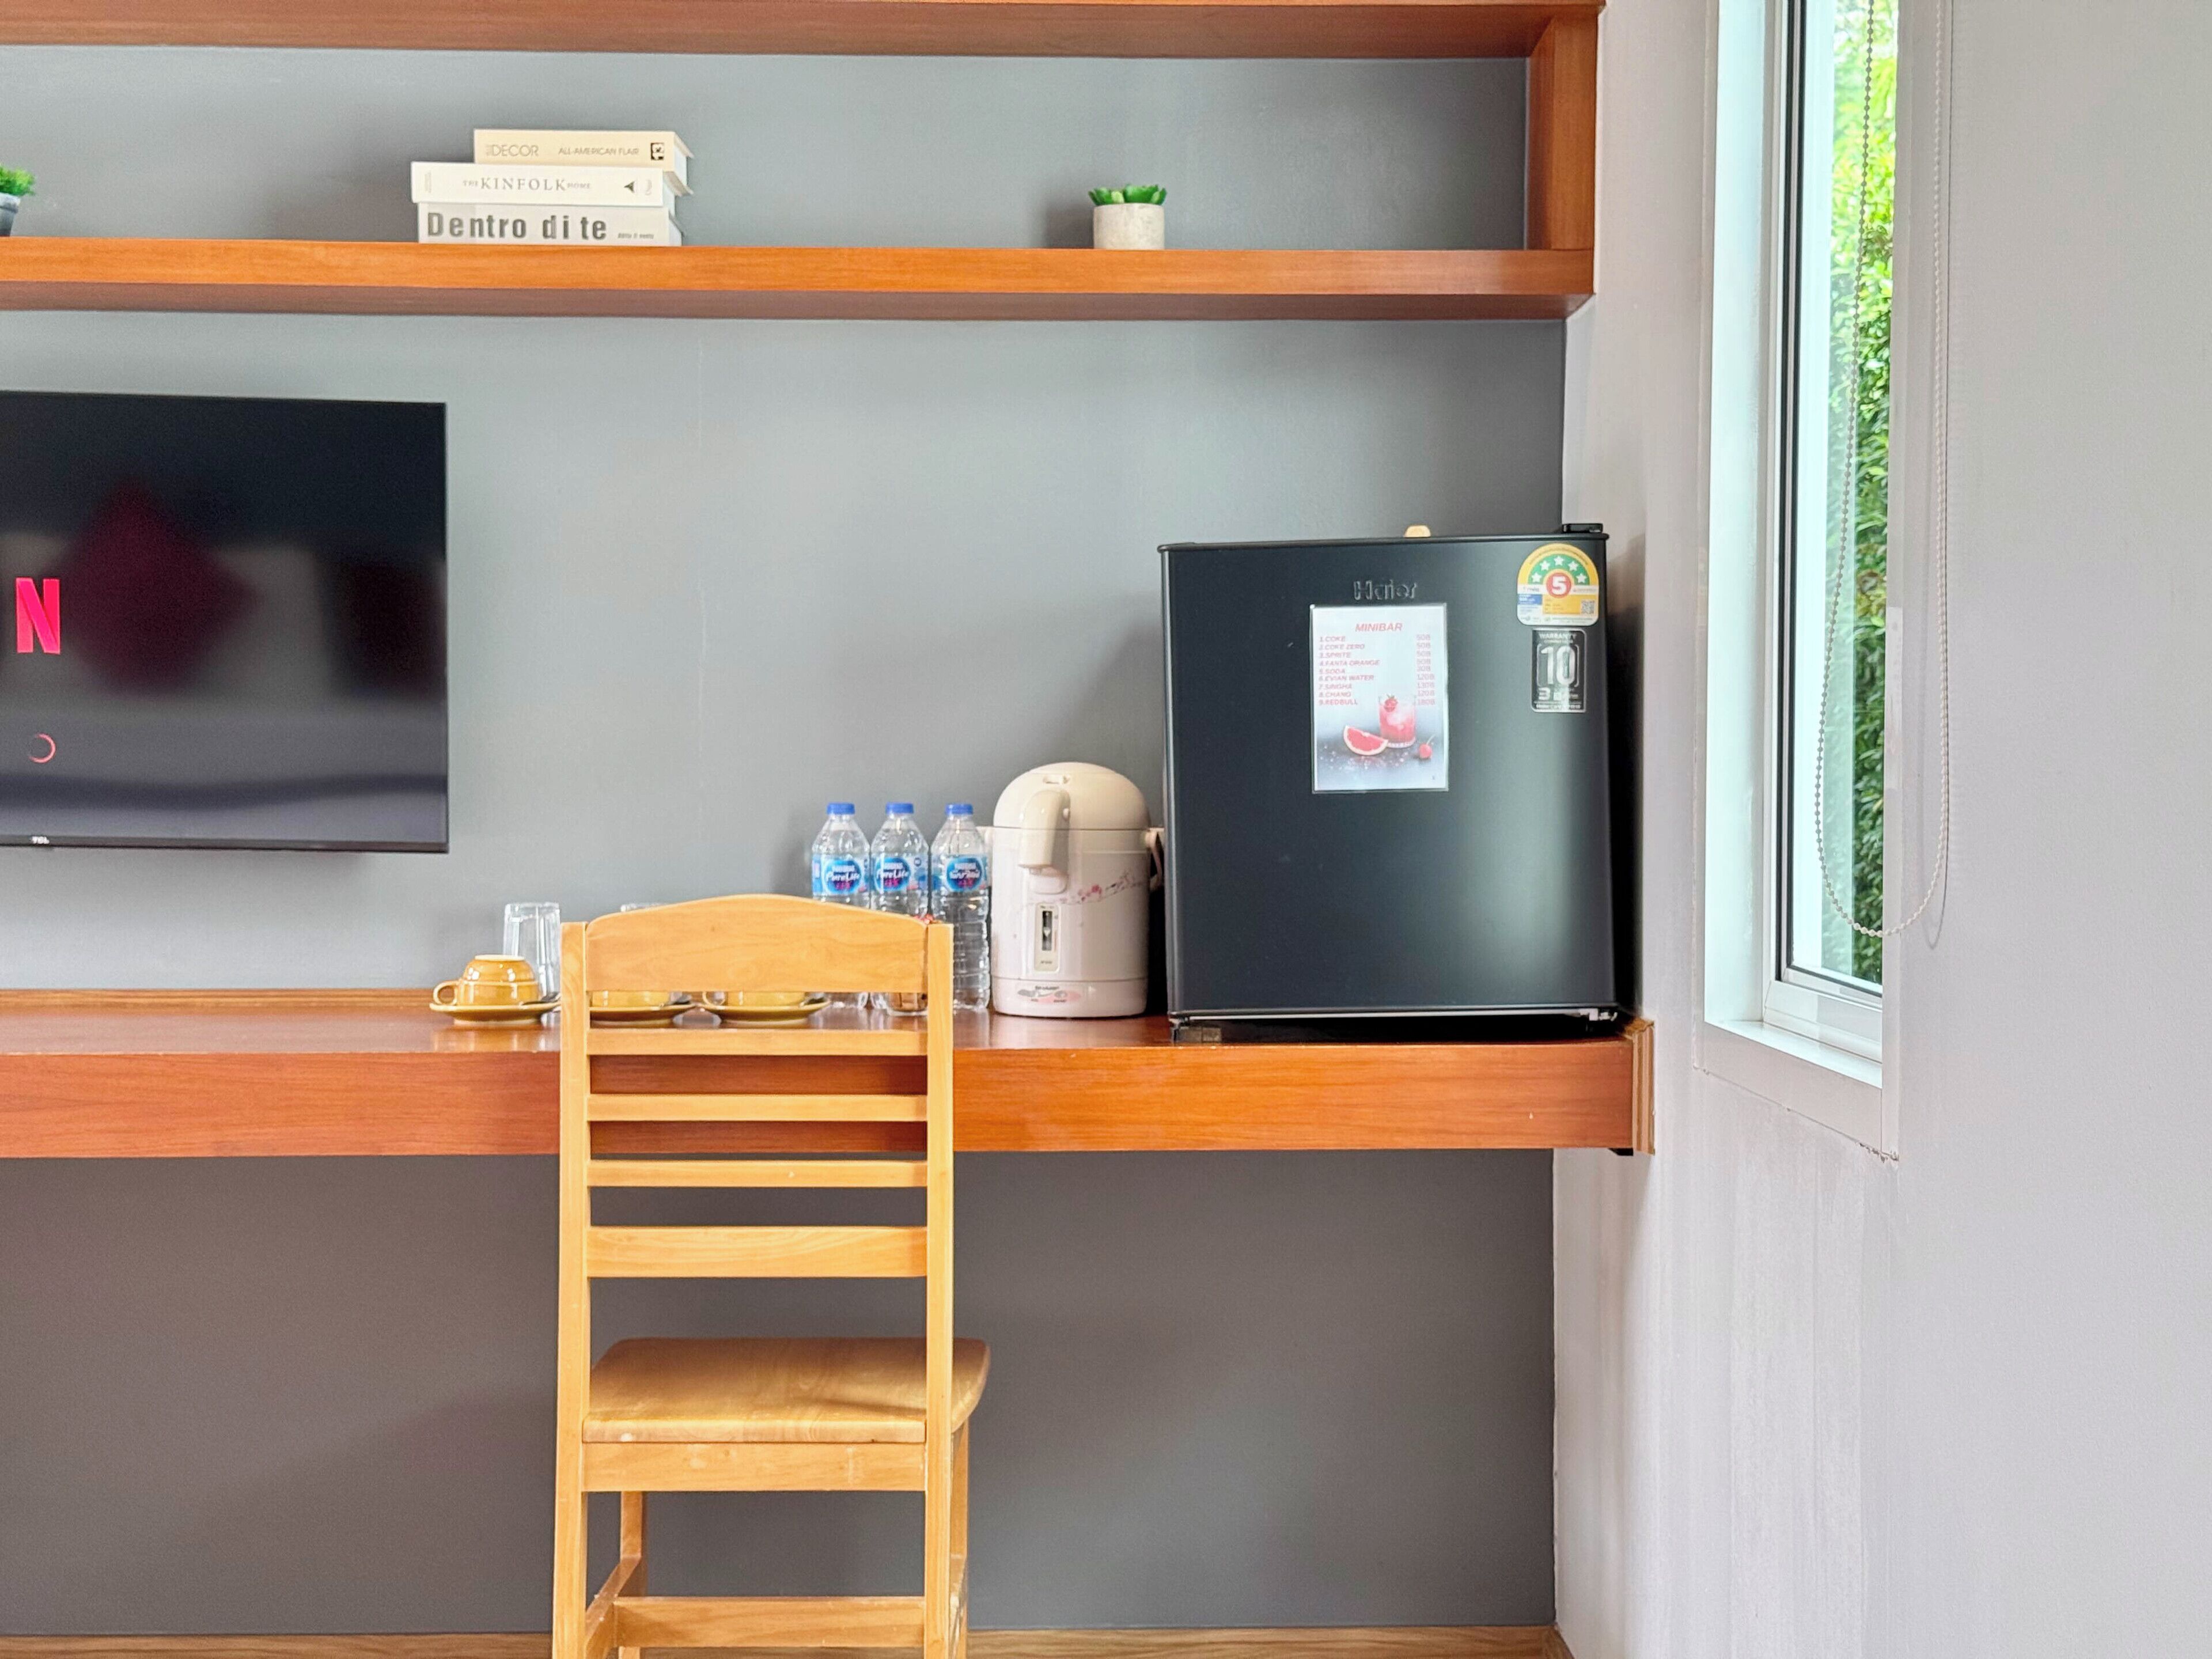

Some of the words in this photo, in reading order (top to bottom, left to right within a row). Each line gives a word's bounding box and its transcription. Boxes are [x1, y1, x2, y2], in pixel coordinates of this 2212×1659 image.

[492, 144, 539, 157] DECOR
[480, 177, 566, 191] KINFOLK
[427, 211, 527, 240] Dentro
[543, 214, 569, 240] di
[580, 215, 607, 241] te
[1551, 575, 1568, 596] 5
[16, 577, 60, 654] N
[1540, 645, 1575, 685] 10
